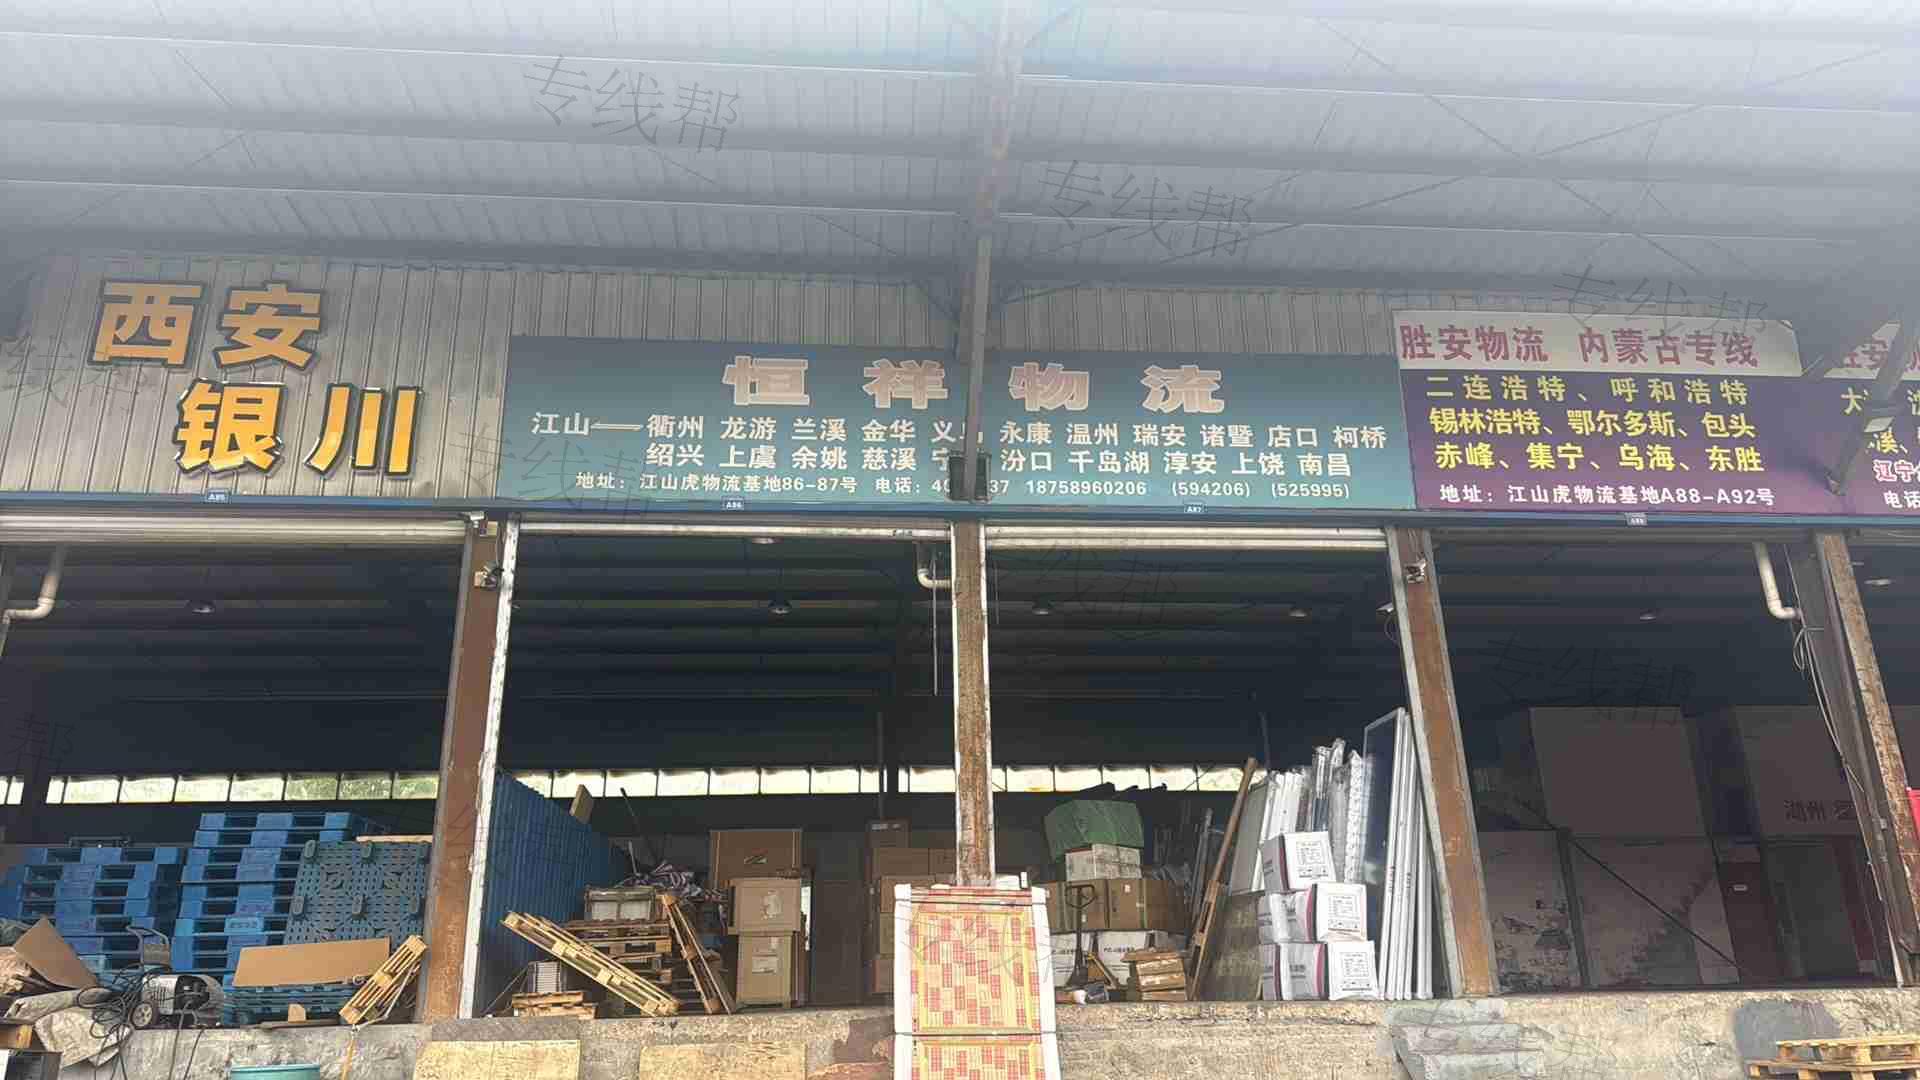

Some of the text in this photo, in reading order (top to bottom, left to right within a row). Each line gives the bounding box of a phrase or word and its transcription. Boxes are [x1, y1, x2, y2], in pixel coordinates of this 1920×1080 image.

[90, 281, 324, 368] 西安
[1400, 325, 1758, 368] 胜安物流 内蒙古专线
[722, 355, 1225, 413] 恒祥物流
[174, 378, 422, 477] 银川
[720, 416, 777, 441] 龙游
[792, 418, 847, 442] 兰溪
[862, 419, 916, 443] 金华
[1000, 421, 1052, 445] 永康
[1066, 423, 1119, 446] 温州
[1133, 424, 1186, 447] 瑞安
[1200, 424, 1254, 448] 诸暨
[1268, 425, 1318, 448] 店口
[1332, 426, 1386, 449] 柯桥
[646, 442, 704, 467] 绍兴
[720, 445, 777, 469] 上虞
[792, 446, 847, 470] 余姚
[862, 447, 917, 471] 慈溪
[1001, 449, 1052, 472] 汾口
[1068, 450, 1150, 474] 千岛湖
[1163, 451, 1217, 475] 淳安
[1232, 452, 1285, 476] 上饶
[1296, 453, 1351, 477] 南昌
[1025, 480, 1147, 496] 18758960206
[1171, 481, 1250, 498] (594206)
[1271, 483, 1350, 499] (525995)
